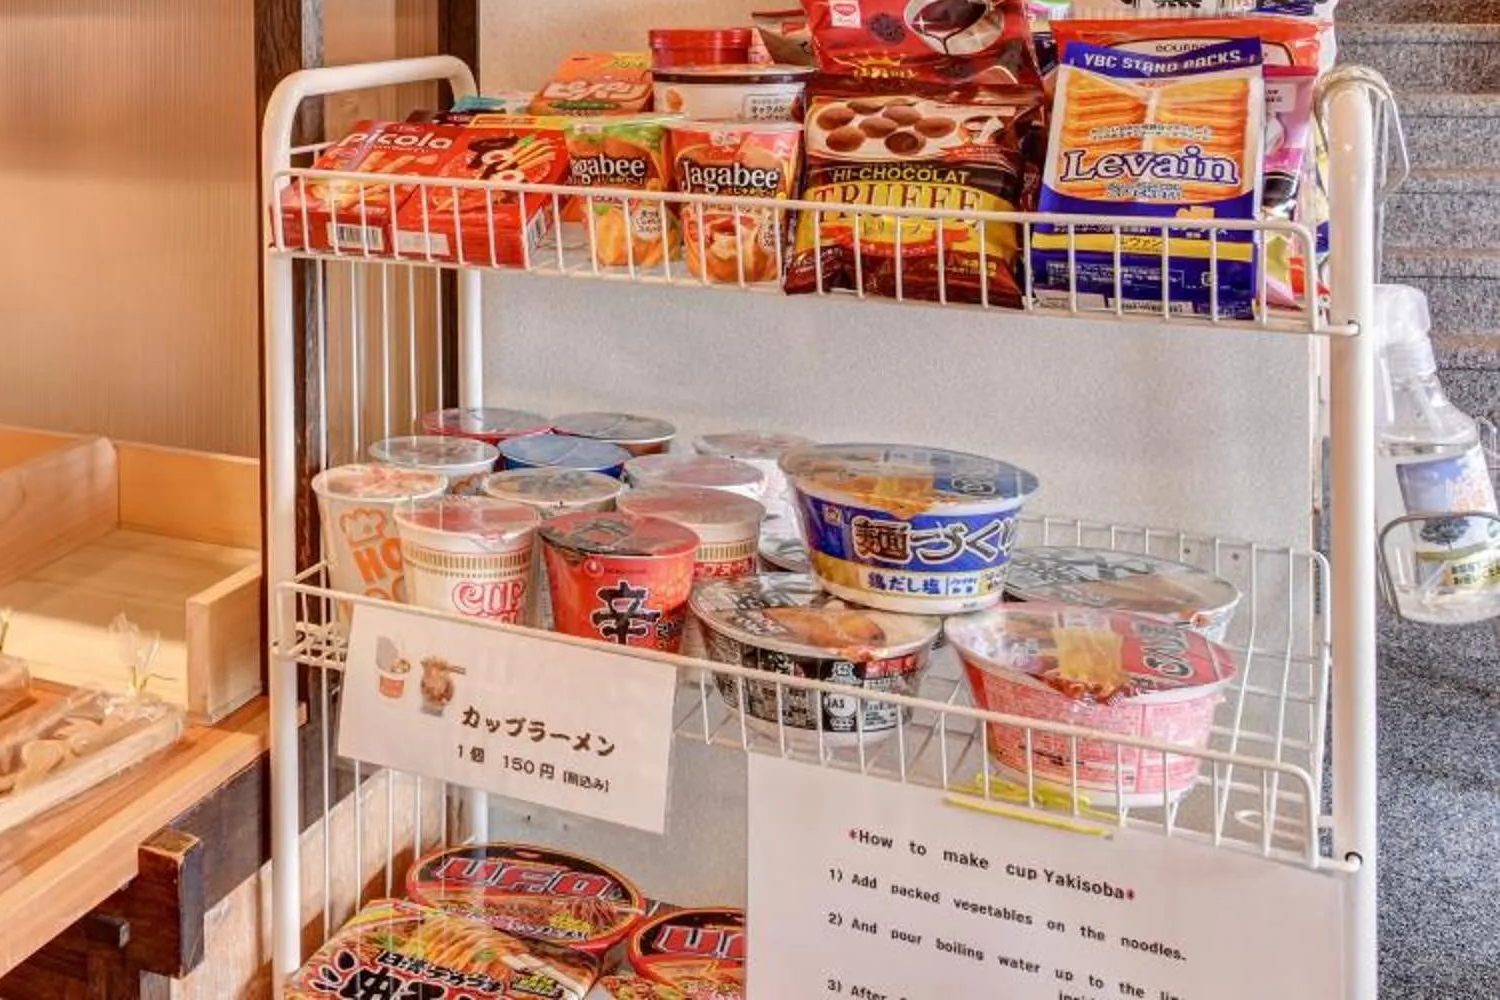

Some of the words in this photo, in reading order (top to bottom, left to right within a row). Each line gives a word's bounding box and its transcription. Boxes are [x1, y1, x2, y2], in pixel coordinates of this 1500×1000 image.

[1083, 53, 1118, 69] YBC
[1122, 58, 1179, 74] STAND
[336, 128, 453, 150] picola
[570, 153, 646, 185] agabee
[681, 160, 780, 195] Jagabee
[832, 166, 971, 184] HI-CHOCOLAT
[1060, 145, 1240, 187] Levain
[851, 514, 1015, 565] 麺づくり
[452, 578, 527, 618] CUP
[867, 571, 941, 595] 鶏だし塩
[591, 579, 661, 645] 辛
[461, 704, 616, 758] カップラーメン
[457, 744, 486, 764] 1個
[503, 755, 555, 780] 150円
[909, 840, 928, 857] to
[943, 849, 990, 871] make
[1005, 862, 1038, 881] cup
[1043, 868, 1125, 900] Yakisoba
[828, 868, 844, 883] 1)
[851, 873, 878, 890] Add
[890, 883, 941, 905] packed
[953, 897, 1033, 926] vegetables
[1046, 919, 1066, 933] on
[1080, 925, 1106, 942] the
[1120, 936, 1188, 962] noodles.
[827, 911, 844, 926] 2)
[851, 917, 878, 935] And
[890, 928, 923, 946] pour
[935, 937, 985, 962] boiling
[997, 954, 1041, 974] water
[1054, 968, 1074, 982] up
[1088, 974, 1105, 990] to
[1118, 981, 1146, 999] the
[826, 979, 843, 994] 3)
